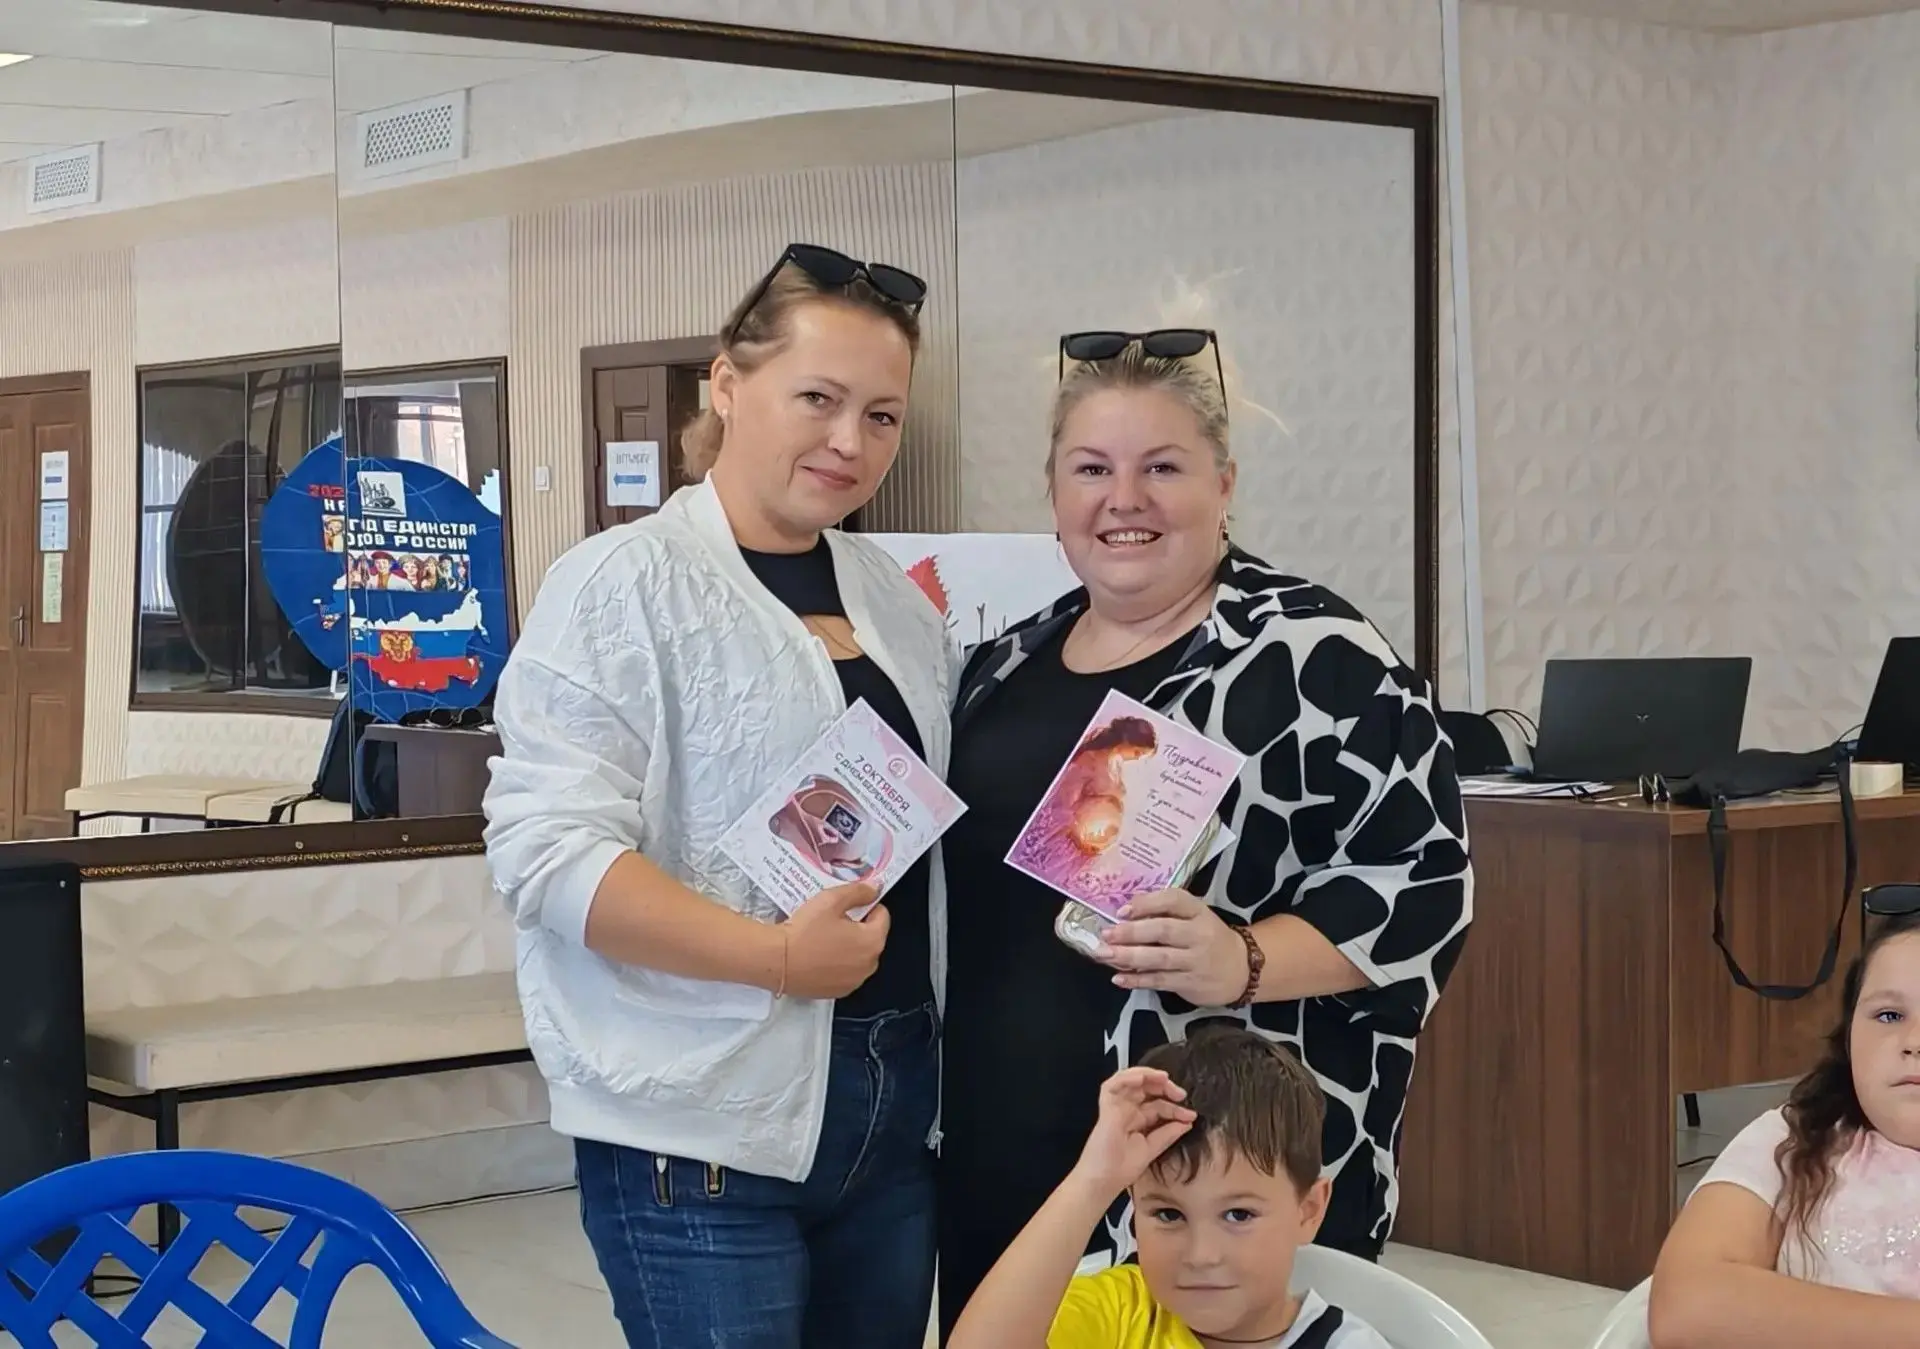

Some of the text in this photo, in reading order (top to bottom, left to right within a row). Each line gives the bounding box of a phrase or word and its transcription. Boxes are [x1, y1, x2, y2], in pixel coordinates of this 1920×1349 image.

[382, 519, 477, 536] ЕДИНСТВА
[394, 534, 468, 551] РОССИИ
[854, 754, 865, 764] 7
[862, 763, 911, 813] ОКТЯБРЯ
